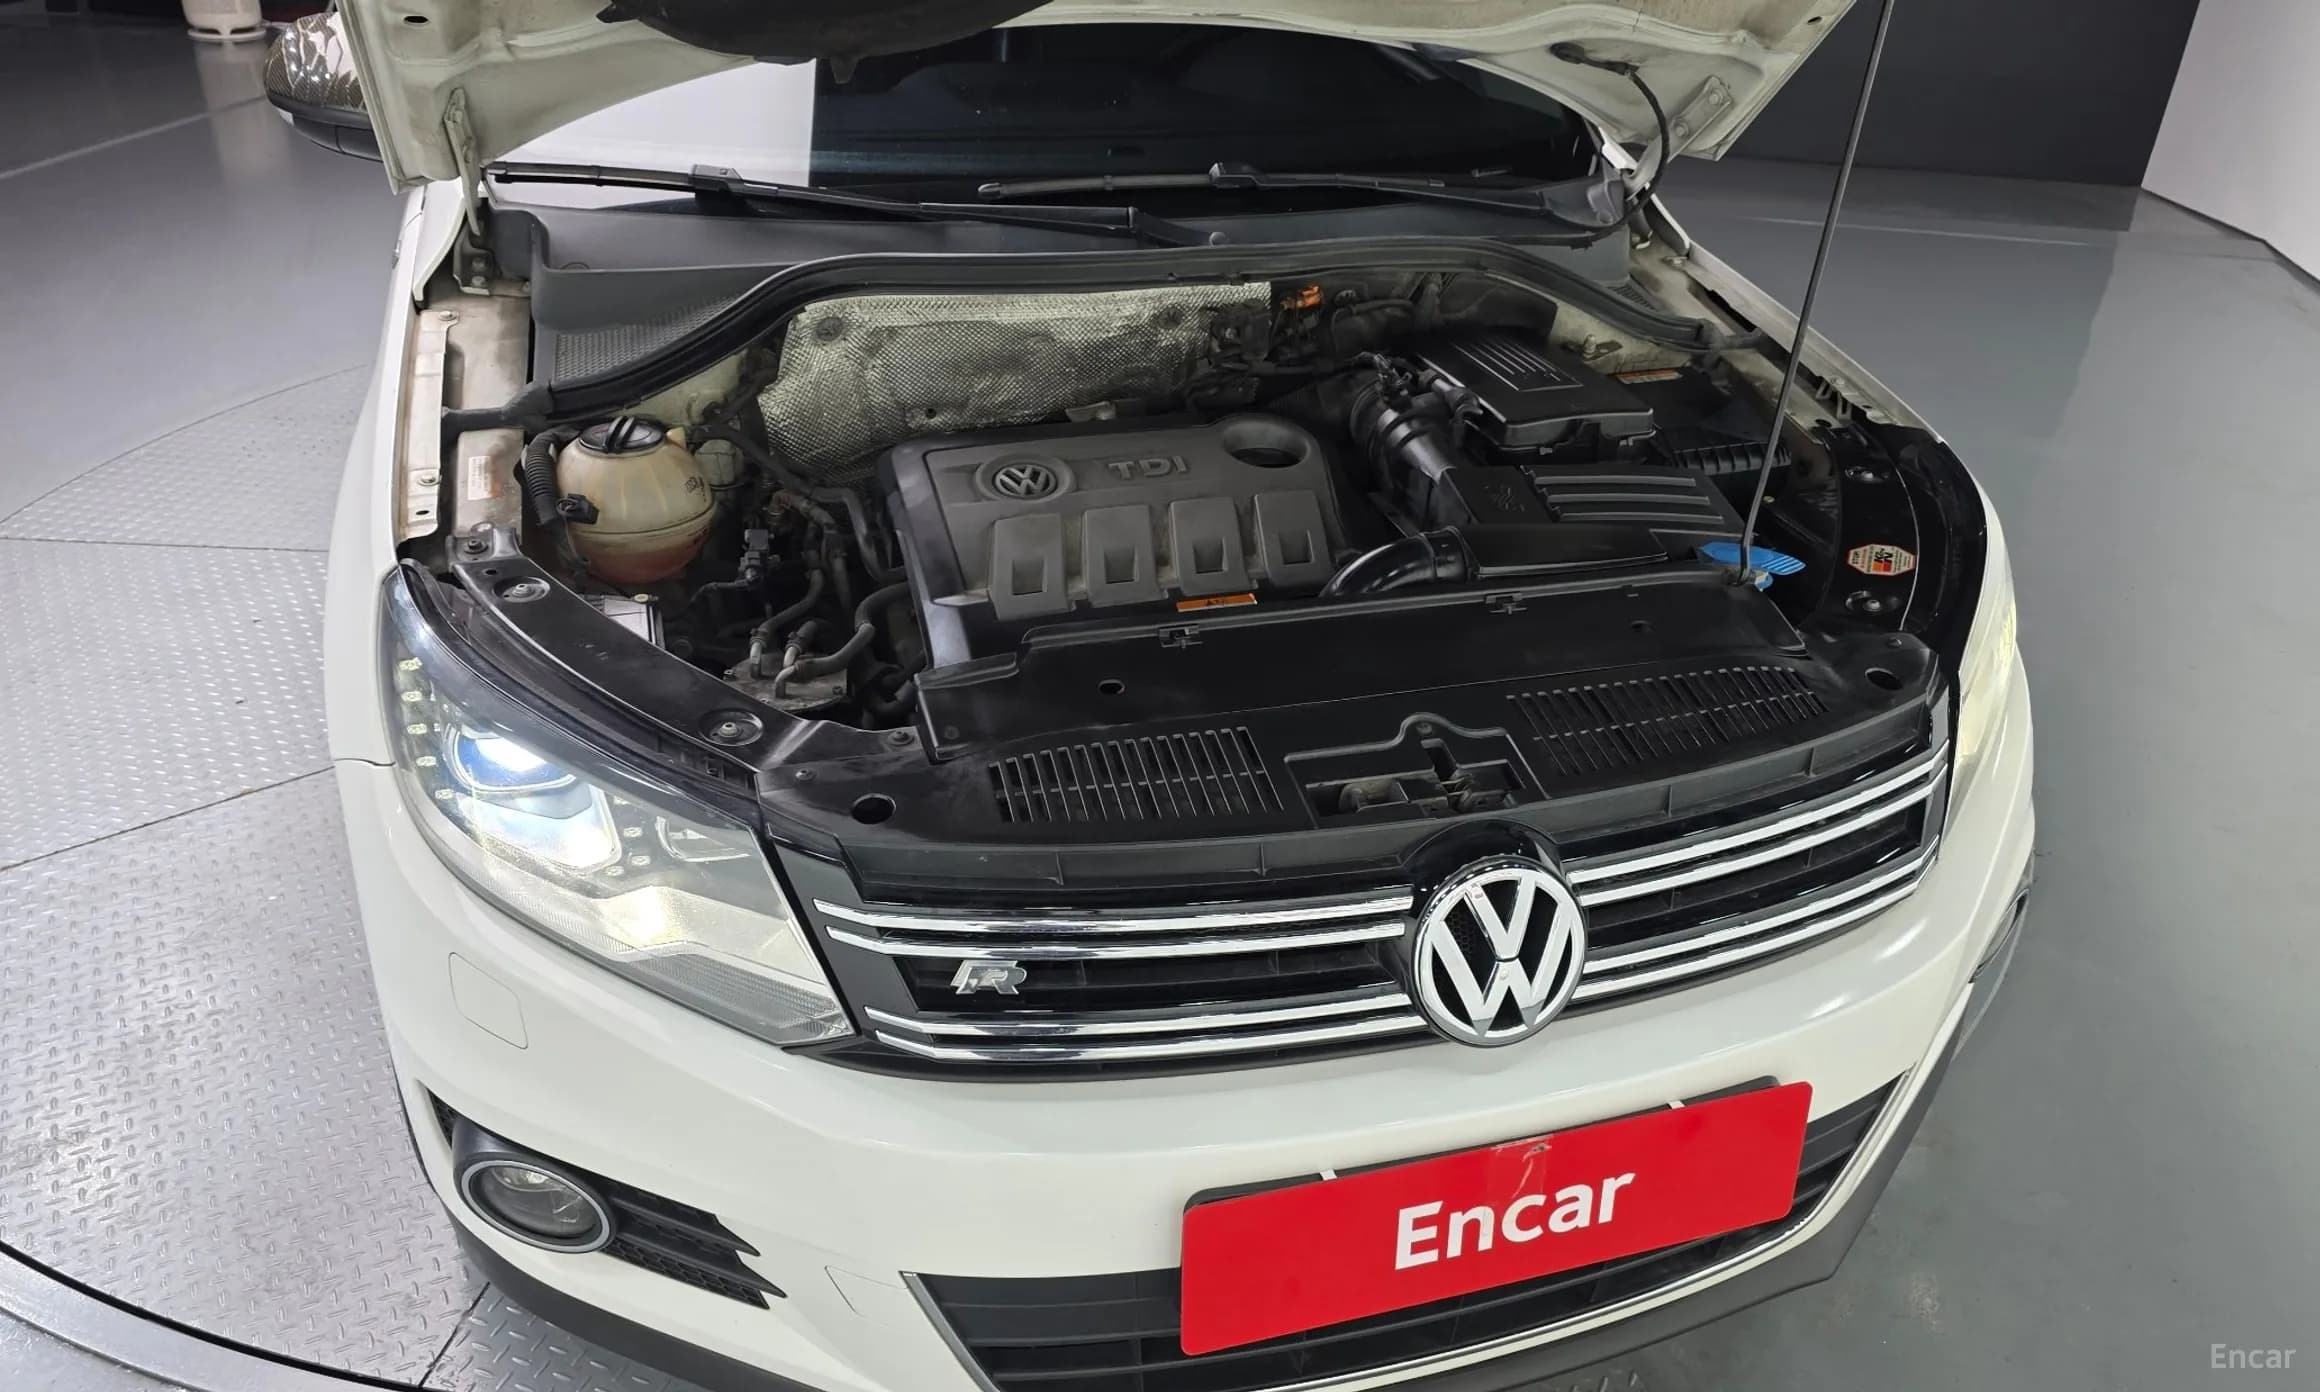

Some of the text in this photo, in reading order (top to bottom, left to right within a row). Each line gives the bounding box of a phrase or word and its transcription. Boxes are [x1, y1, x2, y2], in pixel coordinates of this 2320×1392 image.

[995, 464, 1057, 498] VW
[1108, 456, 1187, 480] TDI
[1417, 866, 1583, 1044] VW
[1395, 1173, 1636, 1270] Encar
